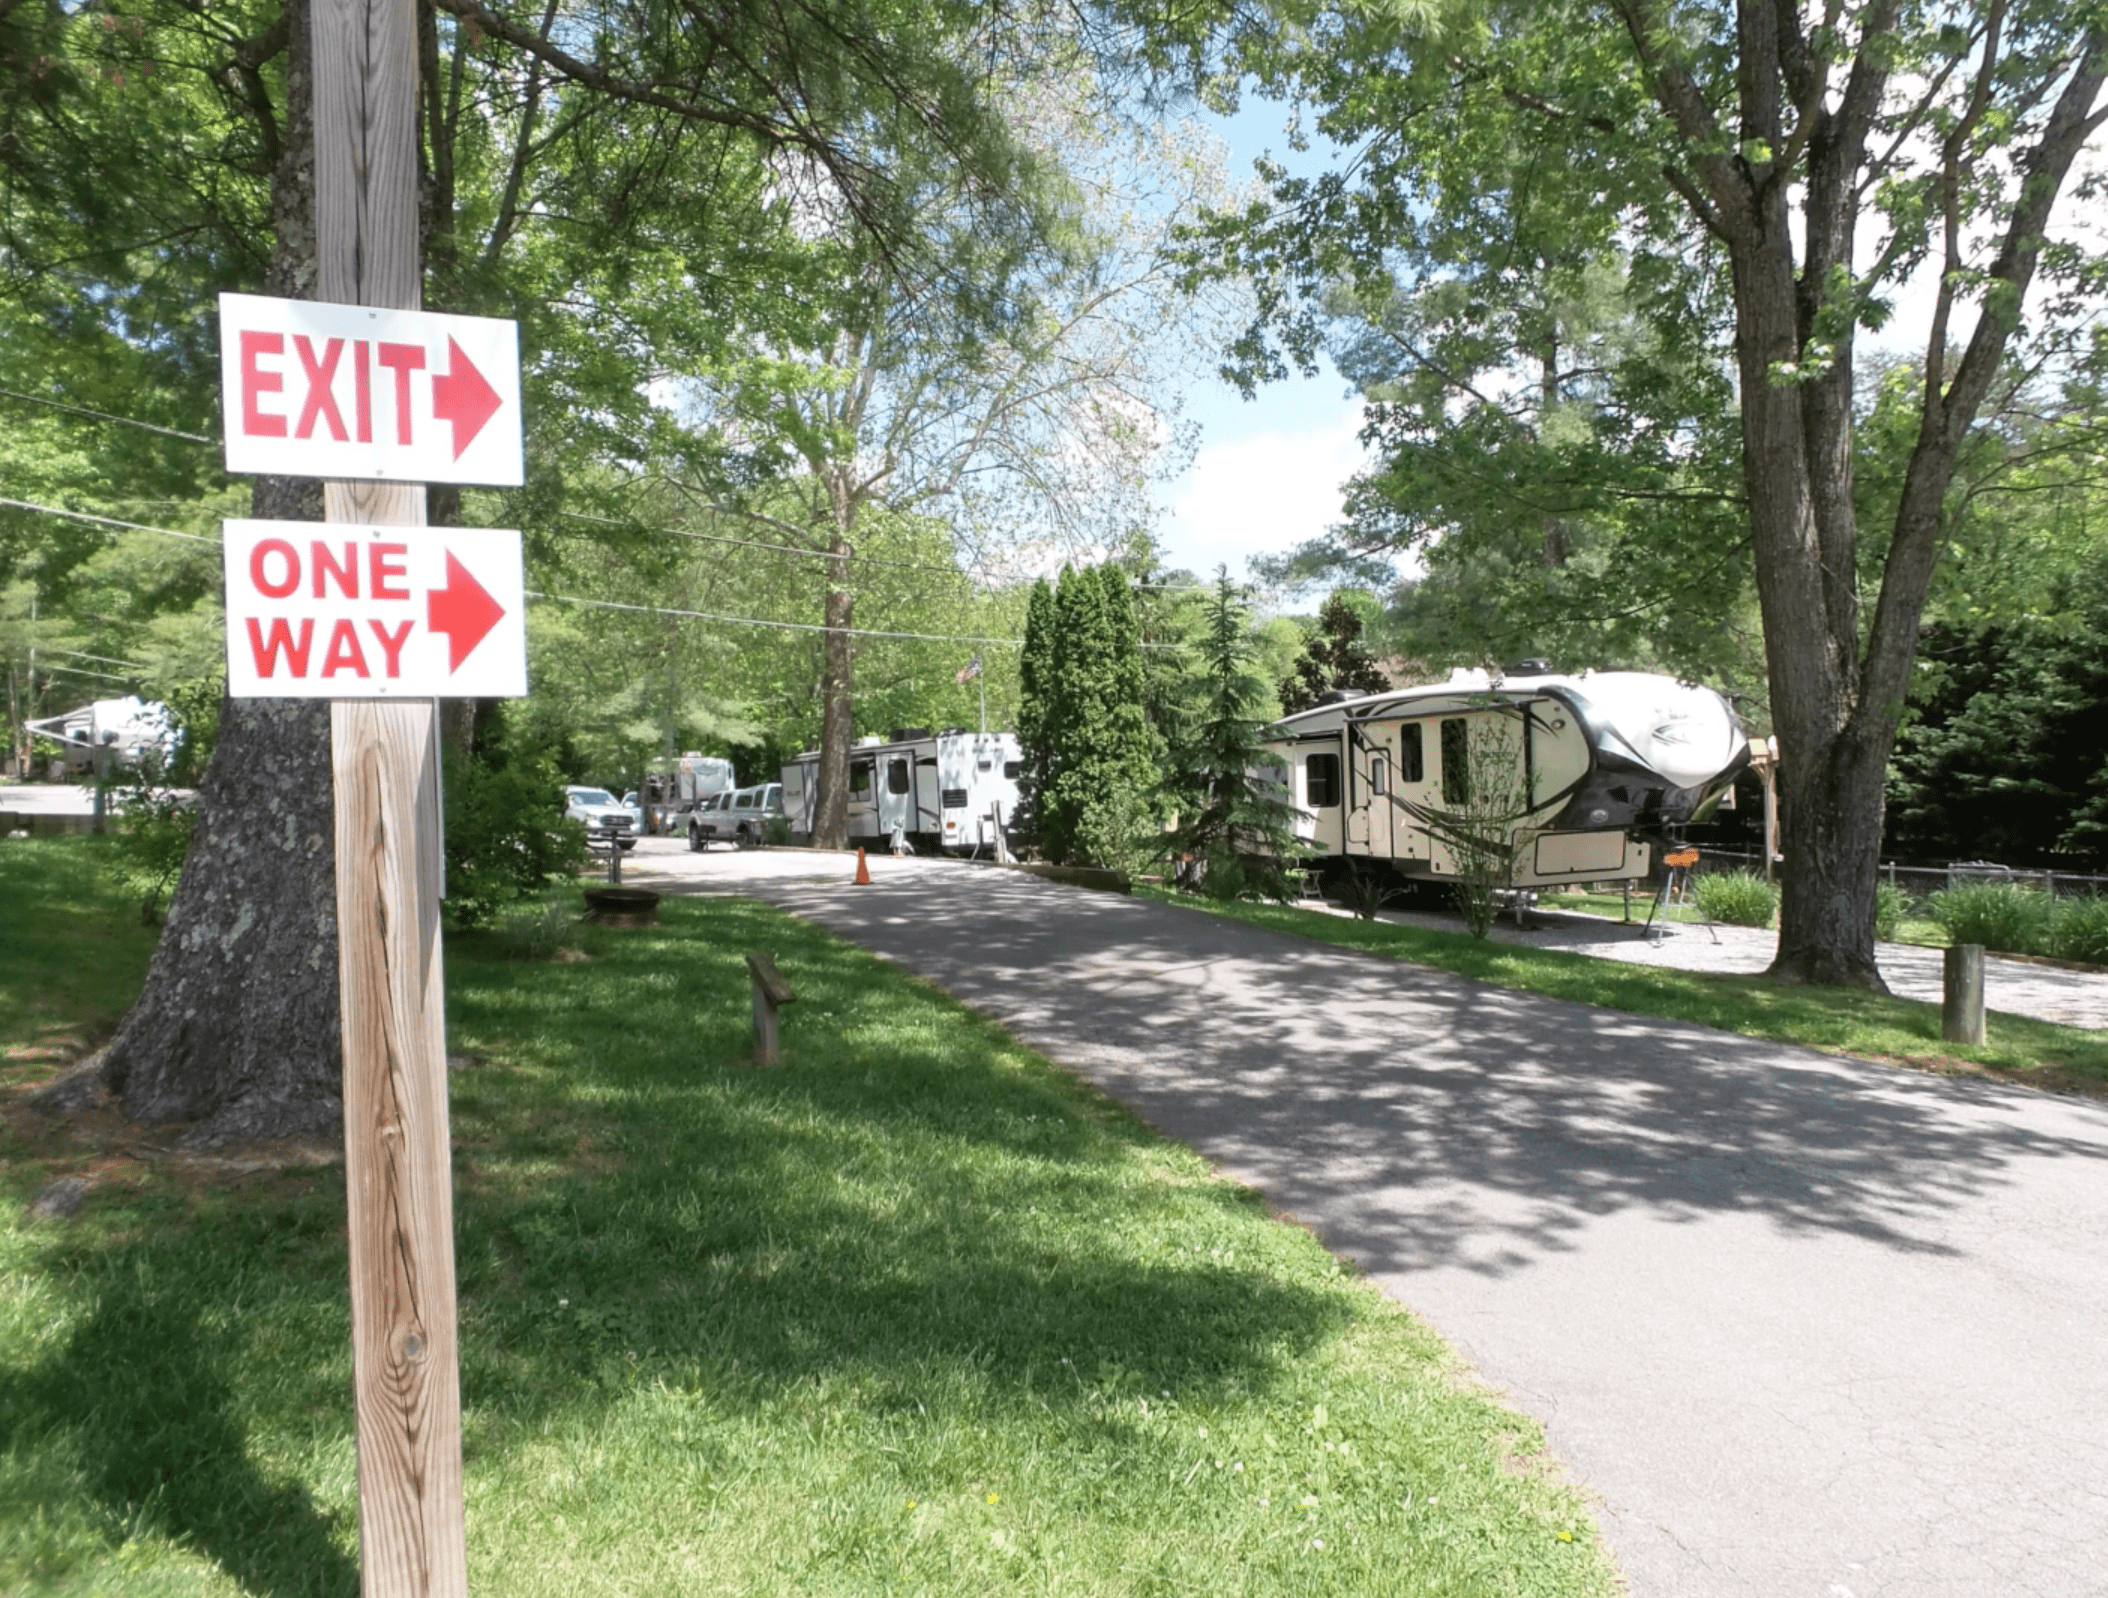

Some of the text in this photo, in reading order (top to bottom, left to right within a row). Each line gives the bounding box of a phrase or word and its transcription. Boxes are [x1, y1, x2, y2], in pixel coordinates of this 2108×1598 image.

[240, 330, 426, 446] EXIT
[249, 538, 410, 601] ONE
[245, 617, 415, 679] WAY
